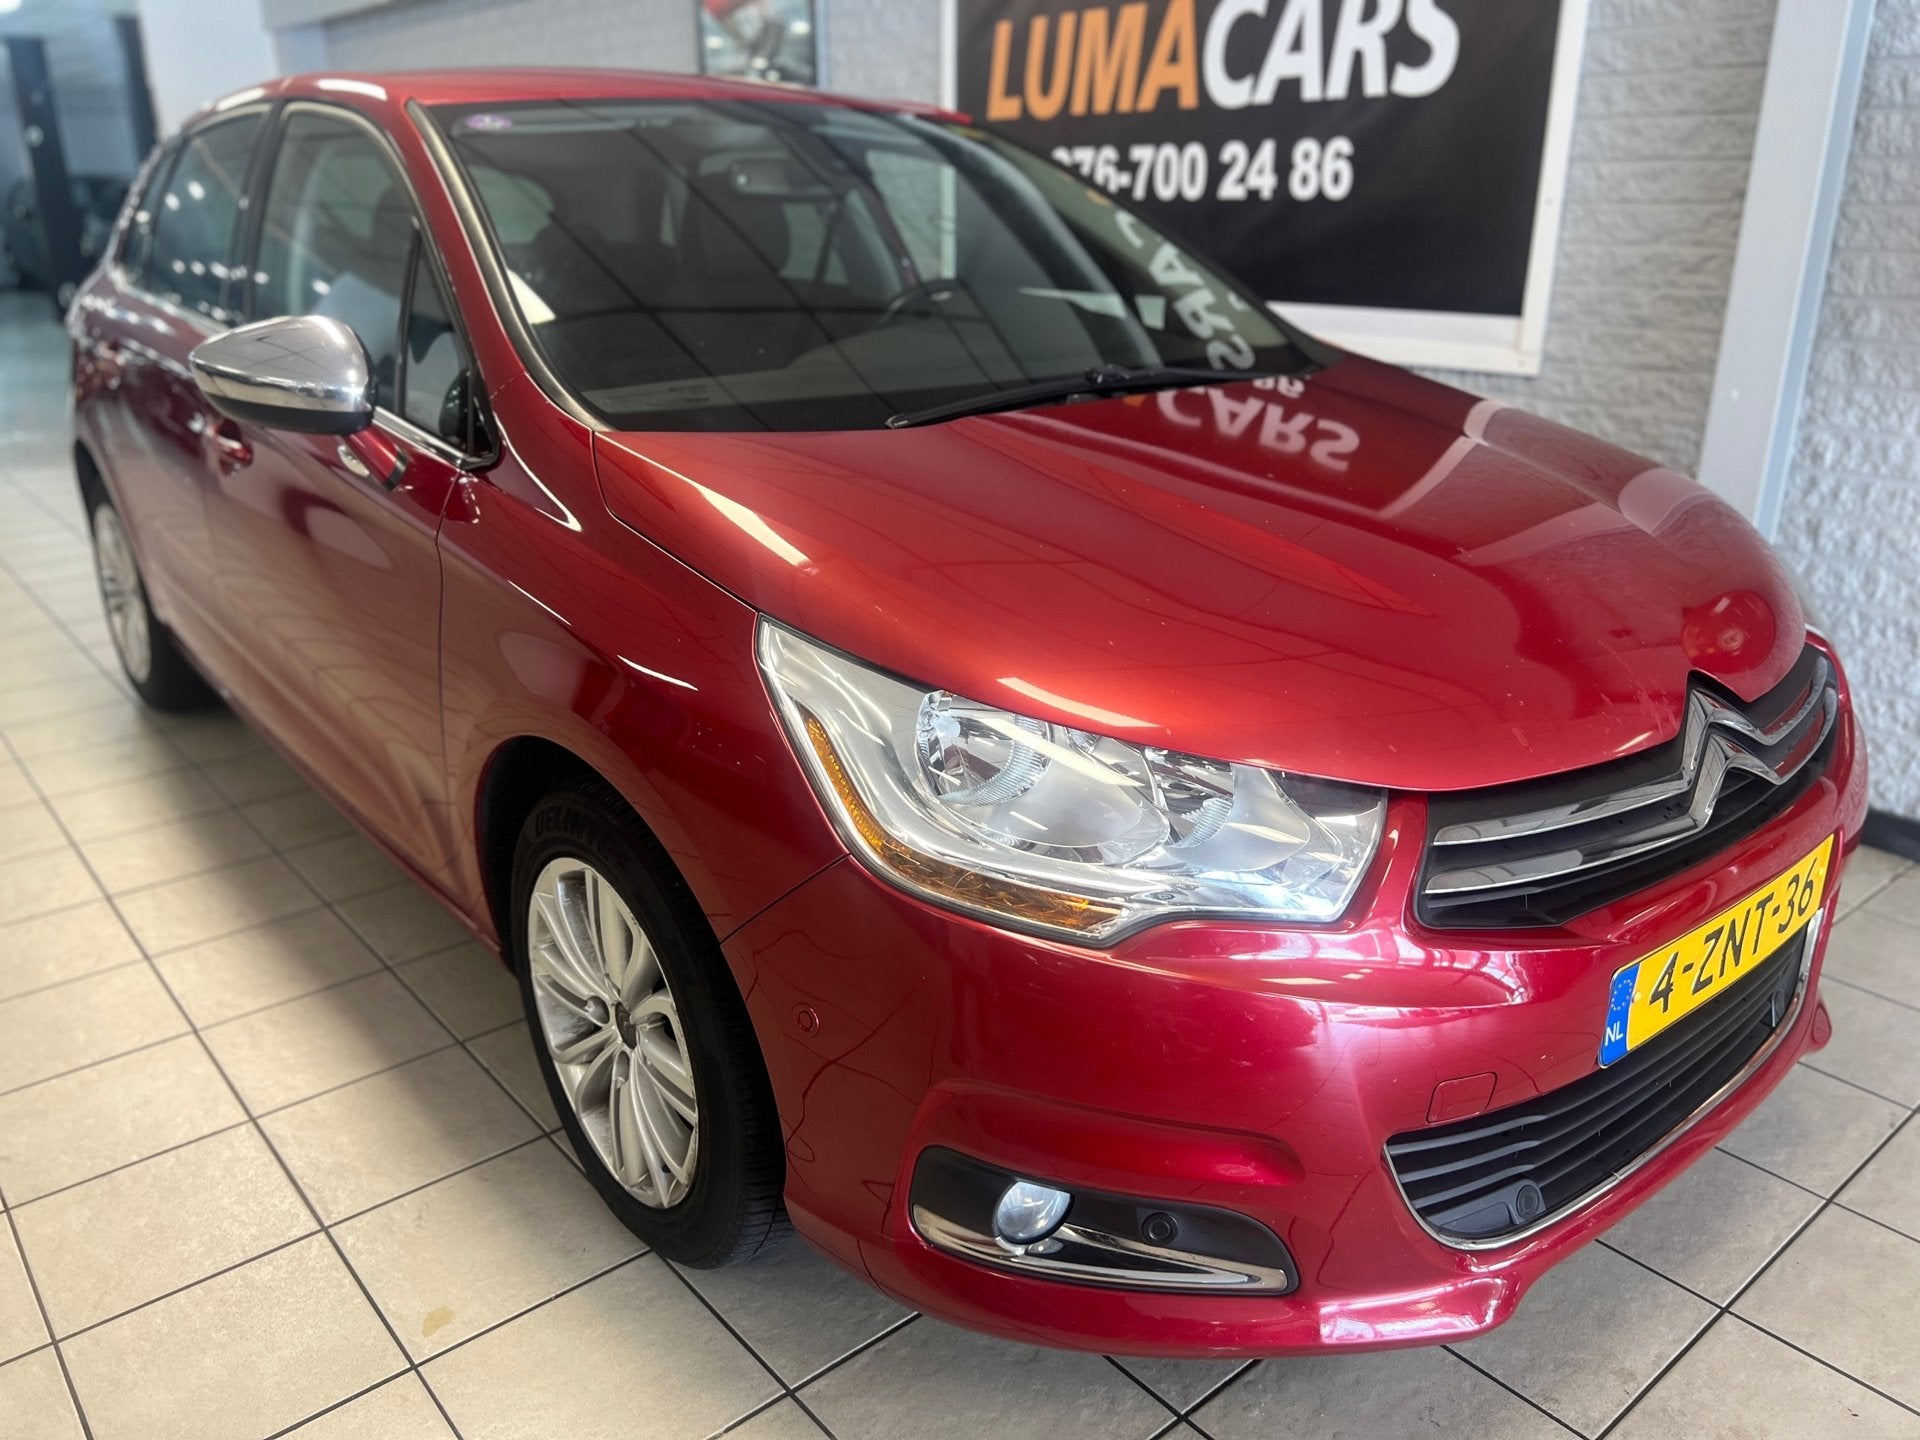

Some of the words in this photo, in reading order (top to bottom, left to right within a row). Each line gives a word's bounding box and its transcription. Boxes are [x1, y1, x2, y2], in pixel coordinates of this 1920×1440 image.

[986, 0, 1460, 121] LUMACARS
[1216, 139, 1278, 200] 24
[1288, 136, 1354, 200] 86
[1649, 857, 1818, 1013] 4-ZNT-36
[1604, 1020, 1624, 1047] NL
